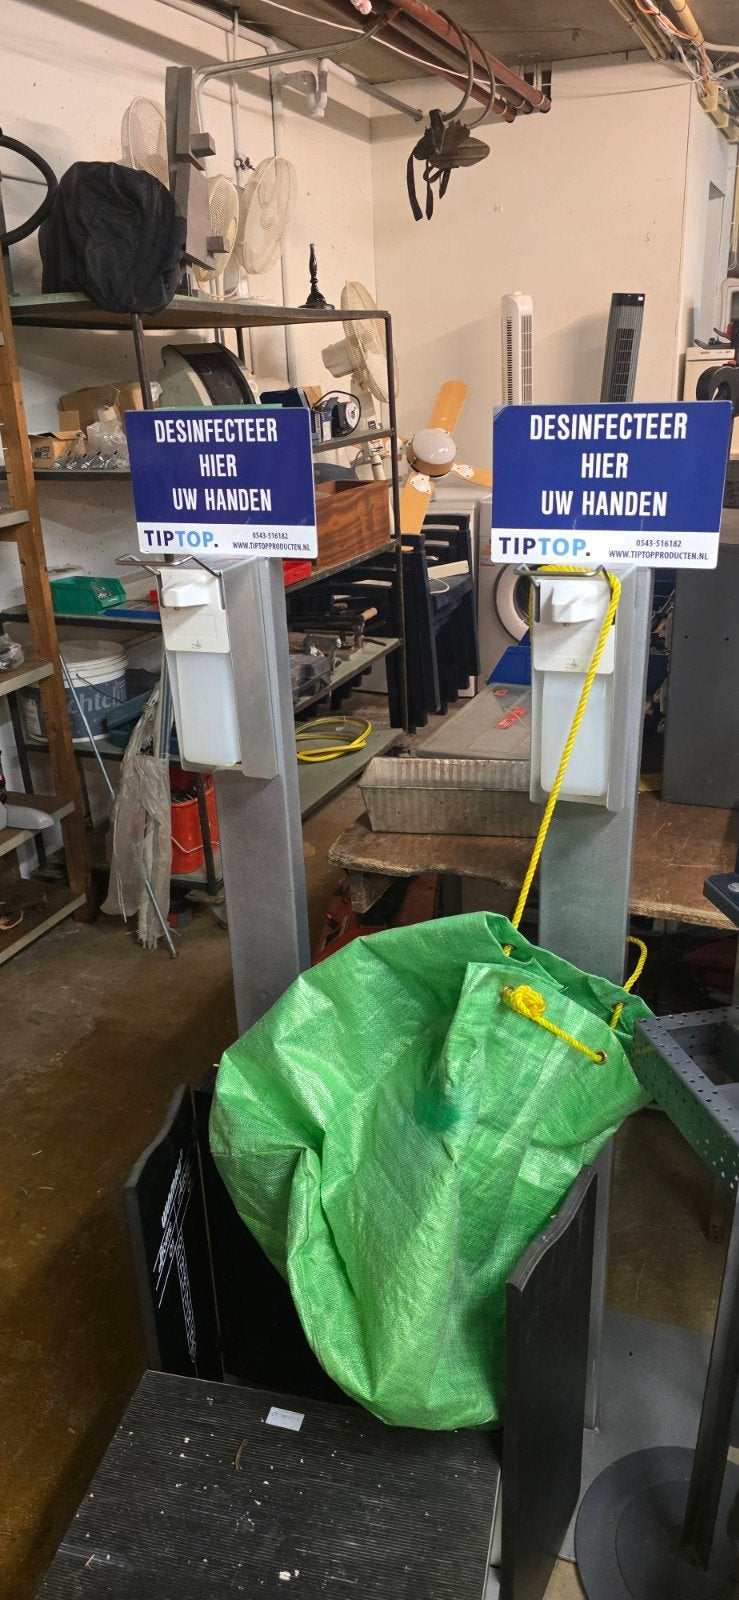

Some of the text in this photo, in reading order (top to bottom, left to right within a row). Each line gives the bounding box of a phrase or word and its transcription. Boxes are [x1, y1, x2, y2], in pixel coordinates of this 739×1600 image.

[154, 418, 278, 443] DESINFECTEER
[530, 412, 688, 440] DESINFECTEER
[199, 454, 238, 477] HIER
[581, 452, 629, 479] HIER
[172, 487, 272, 511] UW HANDEN
[541, 490, 667, 517] UW HANDEN
[232, 541, 311, 551] WWW.TIPTOPPRODUCTEN.NL
[252, 531, 288, 540] 0543-516182
[635, 539, 682, 548] 0543-516182
[608, 550, 708, 561] WWW.TIPTOPPRODUCTEN.NL
